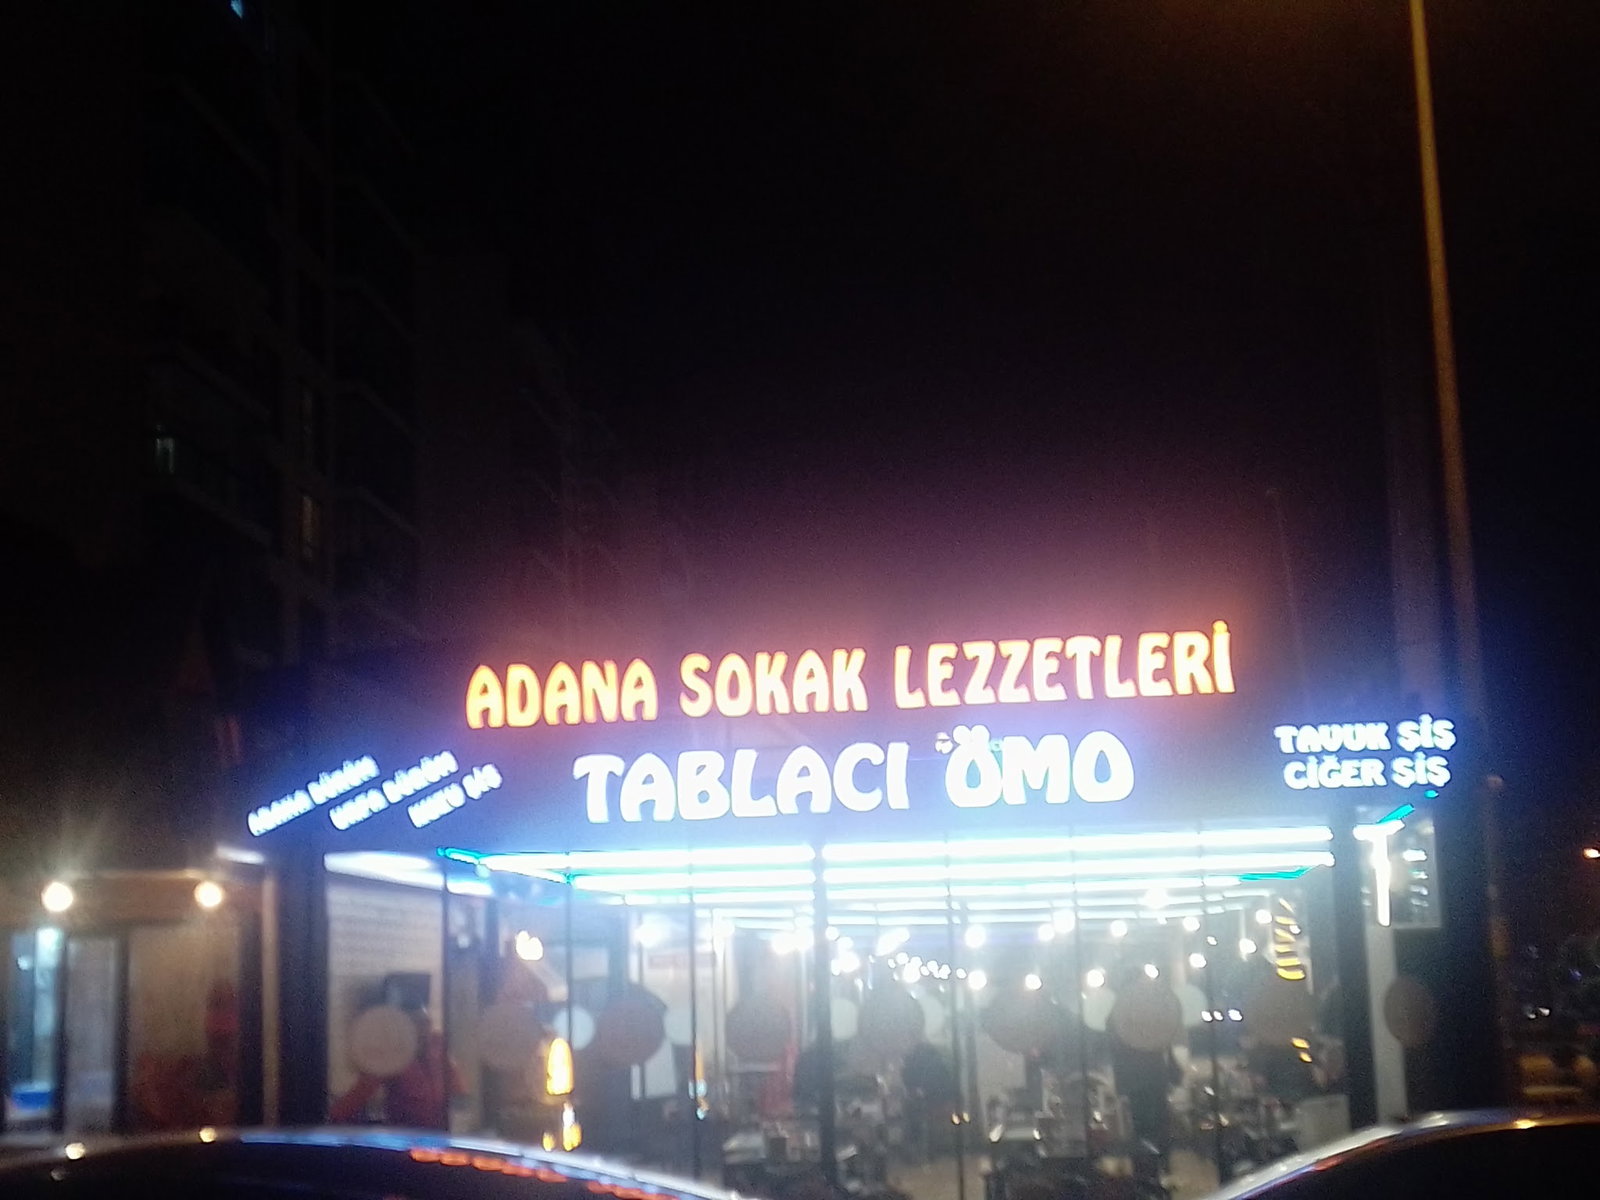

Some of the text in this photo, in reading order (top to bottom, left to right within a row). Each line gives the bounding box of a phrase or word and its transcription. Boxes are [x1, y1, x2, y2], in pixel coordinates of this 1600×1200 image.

[466, 620, 1236, 729] ADANA SOKAK LEZZETLERİ
[573, 741, 910, 824] TABLACI
[945, 724, 1135, 808] ÖMO
[1283, 753, 1388, 790] CİĞER
